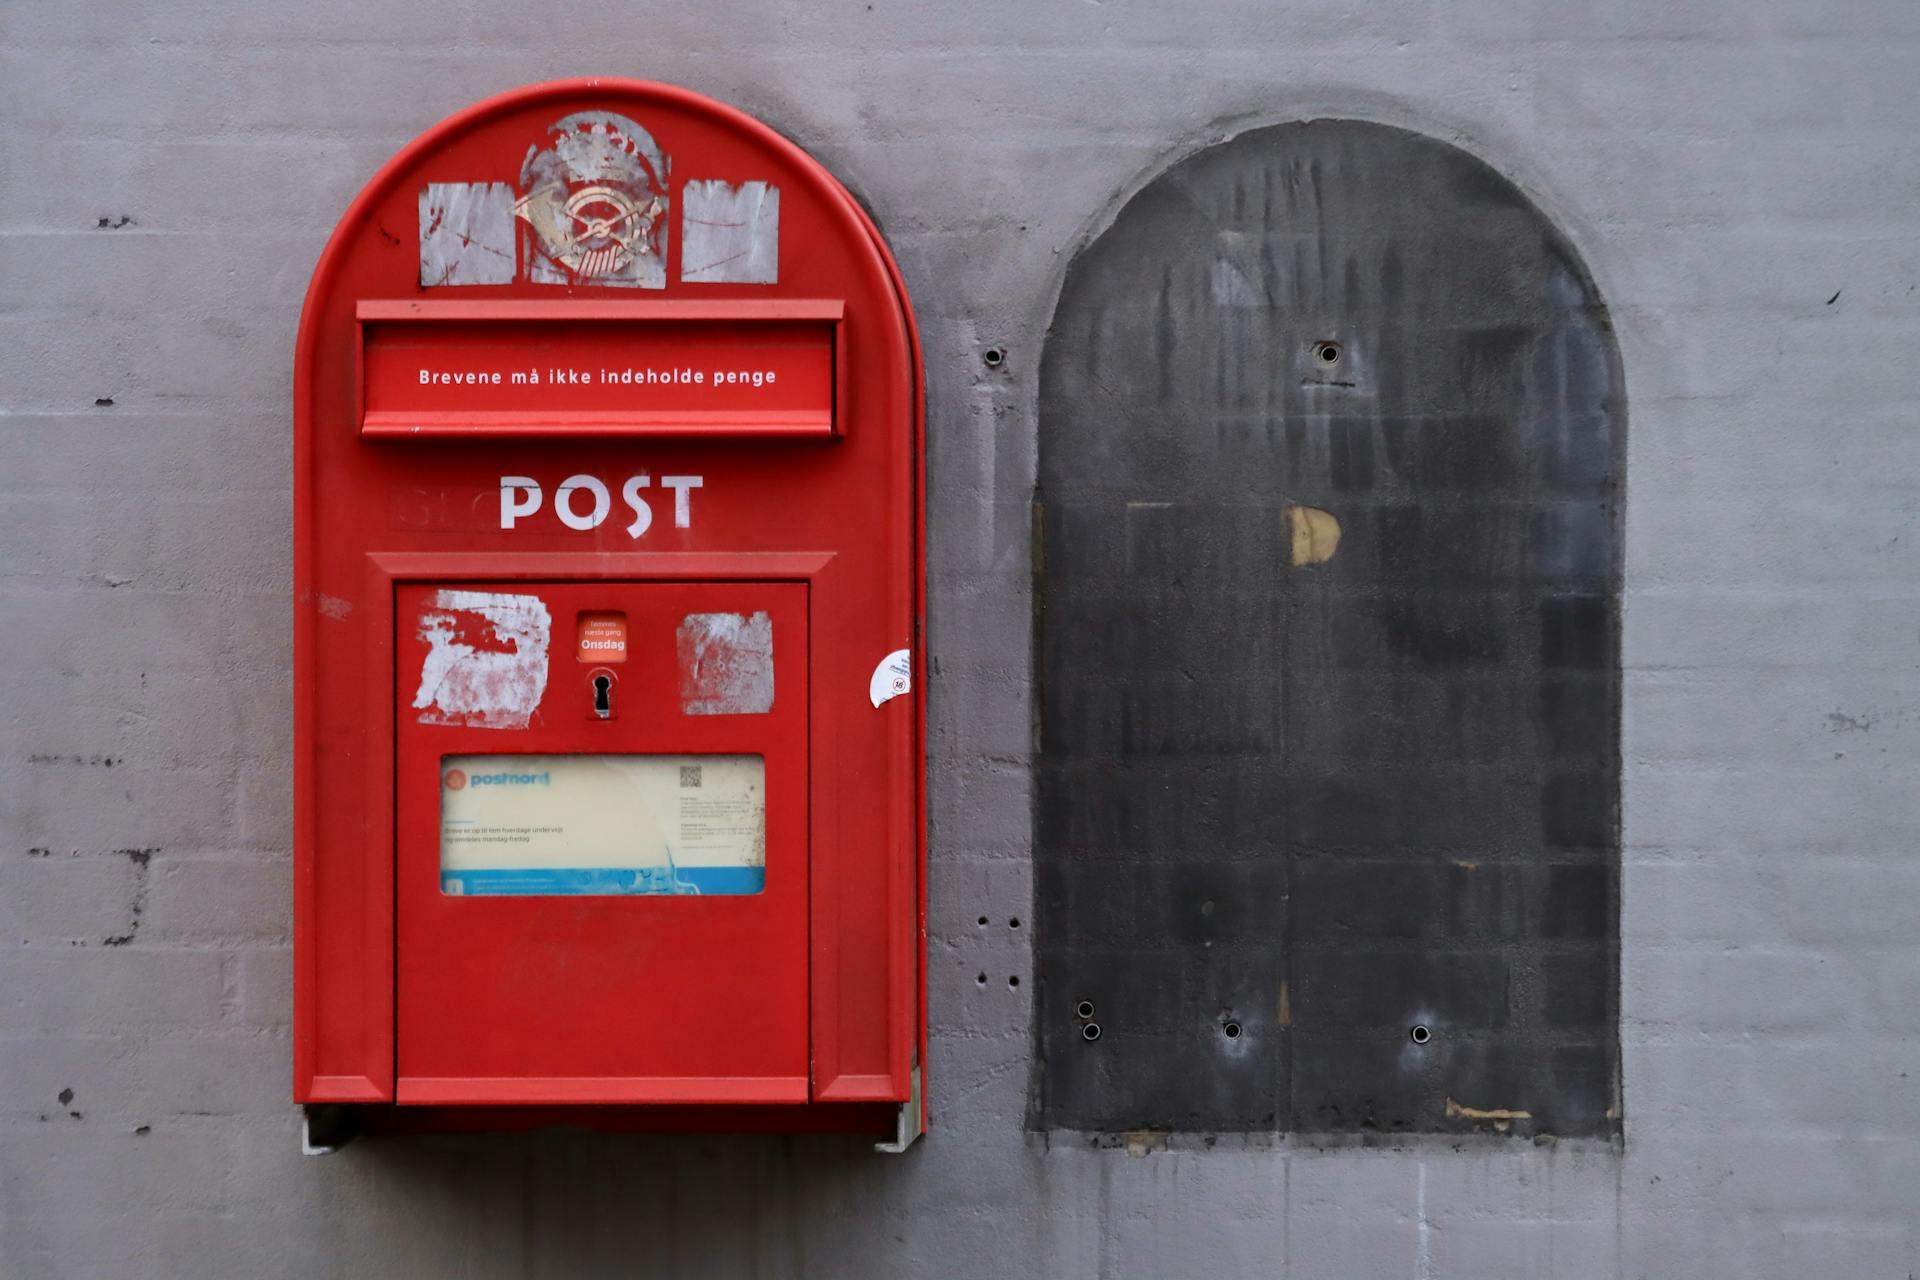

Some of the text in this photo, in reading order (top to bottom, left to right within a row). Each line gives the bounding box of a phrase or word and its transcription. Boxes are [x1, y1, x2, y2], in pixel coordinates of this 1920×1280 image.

[419, 368, 776, 387] Brevene må ikke indeholde penge
[500, 474, 703, 539] POST
[581, 639, 625, 651] Onsdag
[471, 771, 550, 788] postnord
